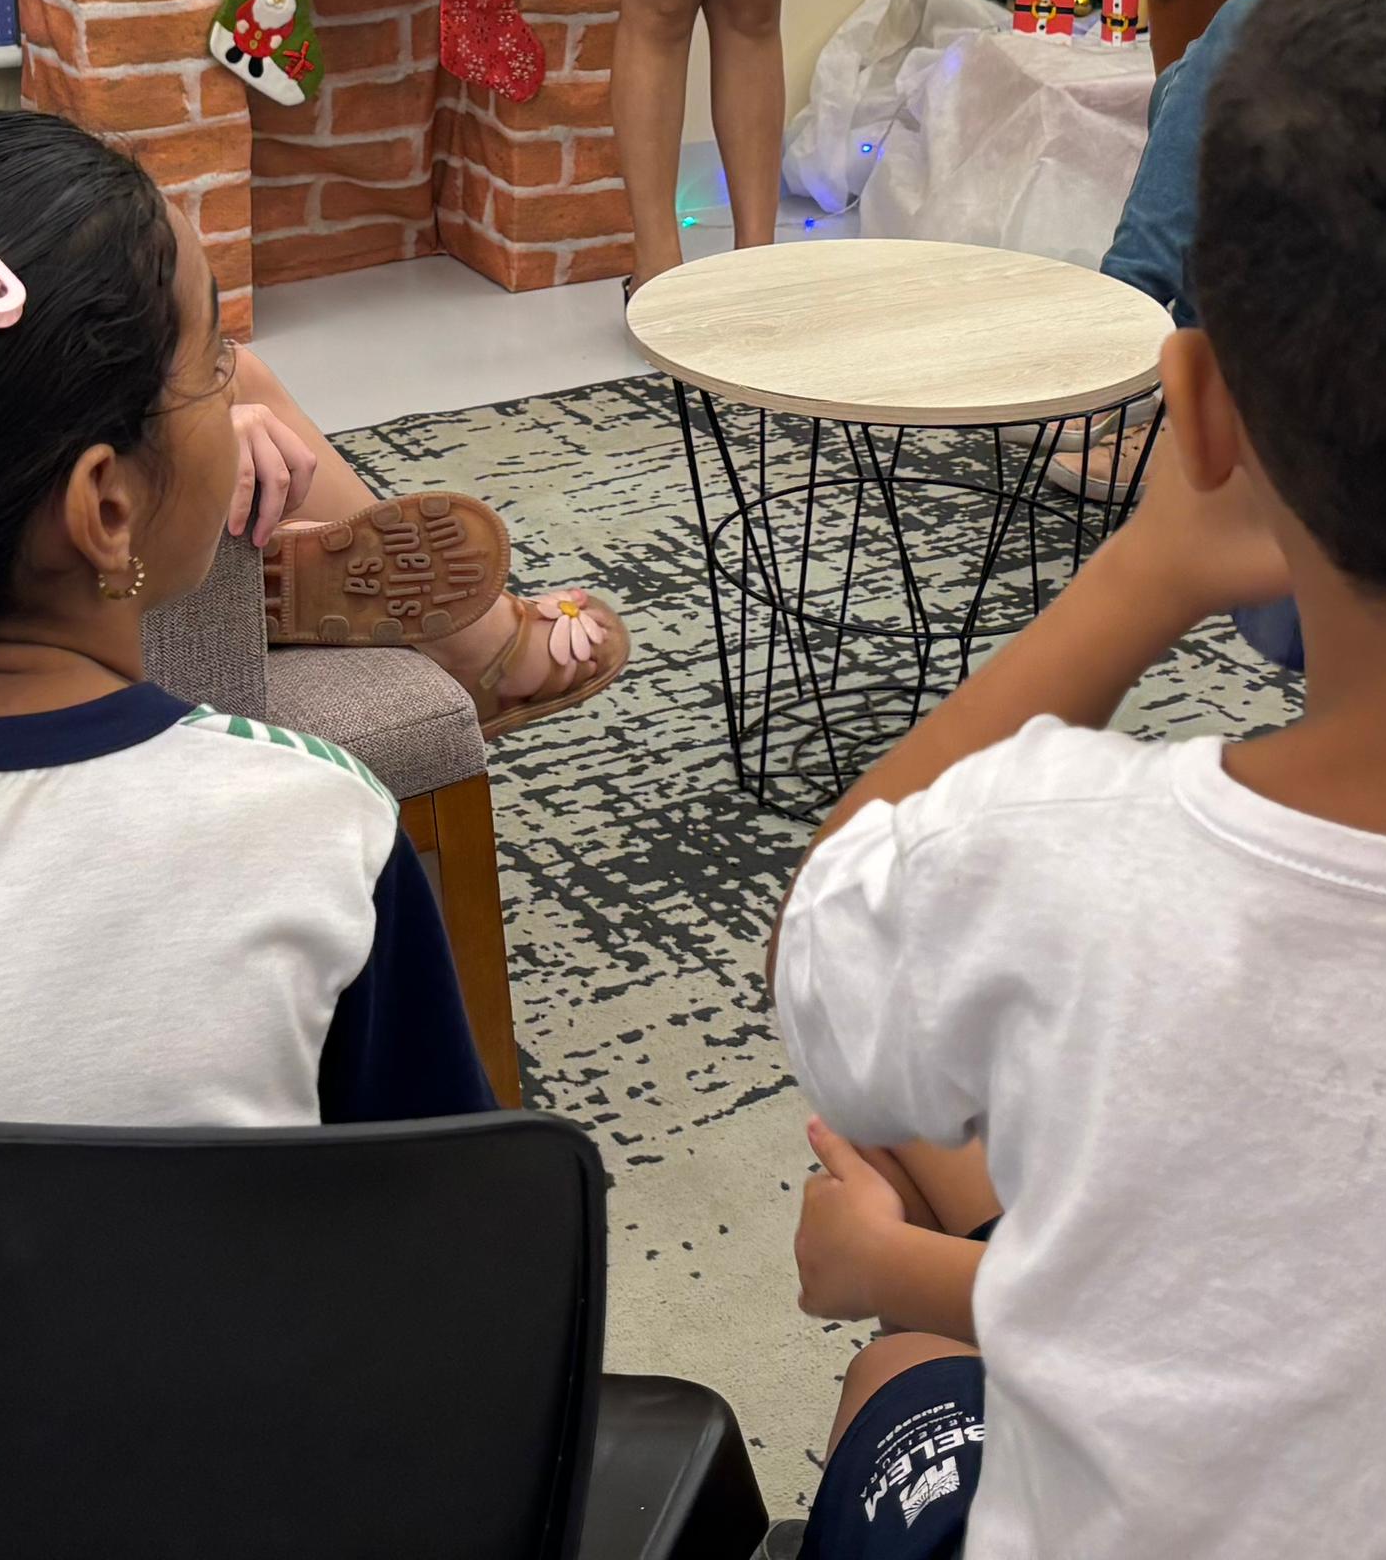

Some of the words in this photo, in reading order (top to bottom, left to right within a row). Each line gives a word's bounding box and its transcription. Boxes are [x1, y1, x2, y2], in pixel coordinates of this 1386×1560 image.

[344, 557, 383, 596] sa
[382, 522, 436, 617] melis
[425, 515, 487, 605] mini
